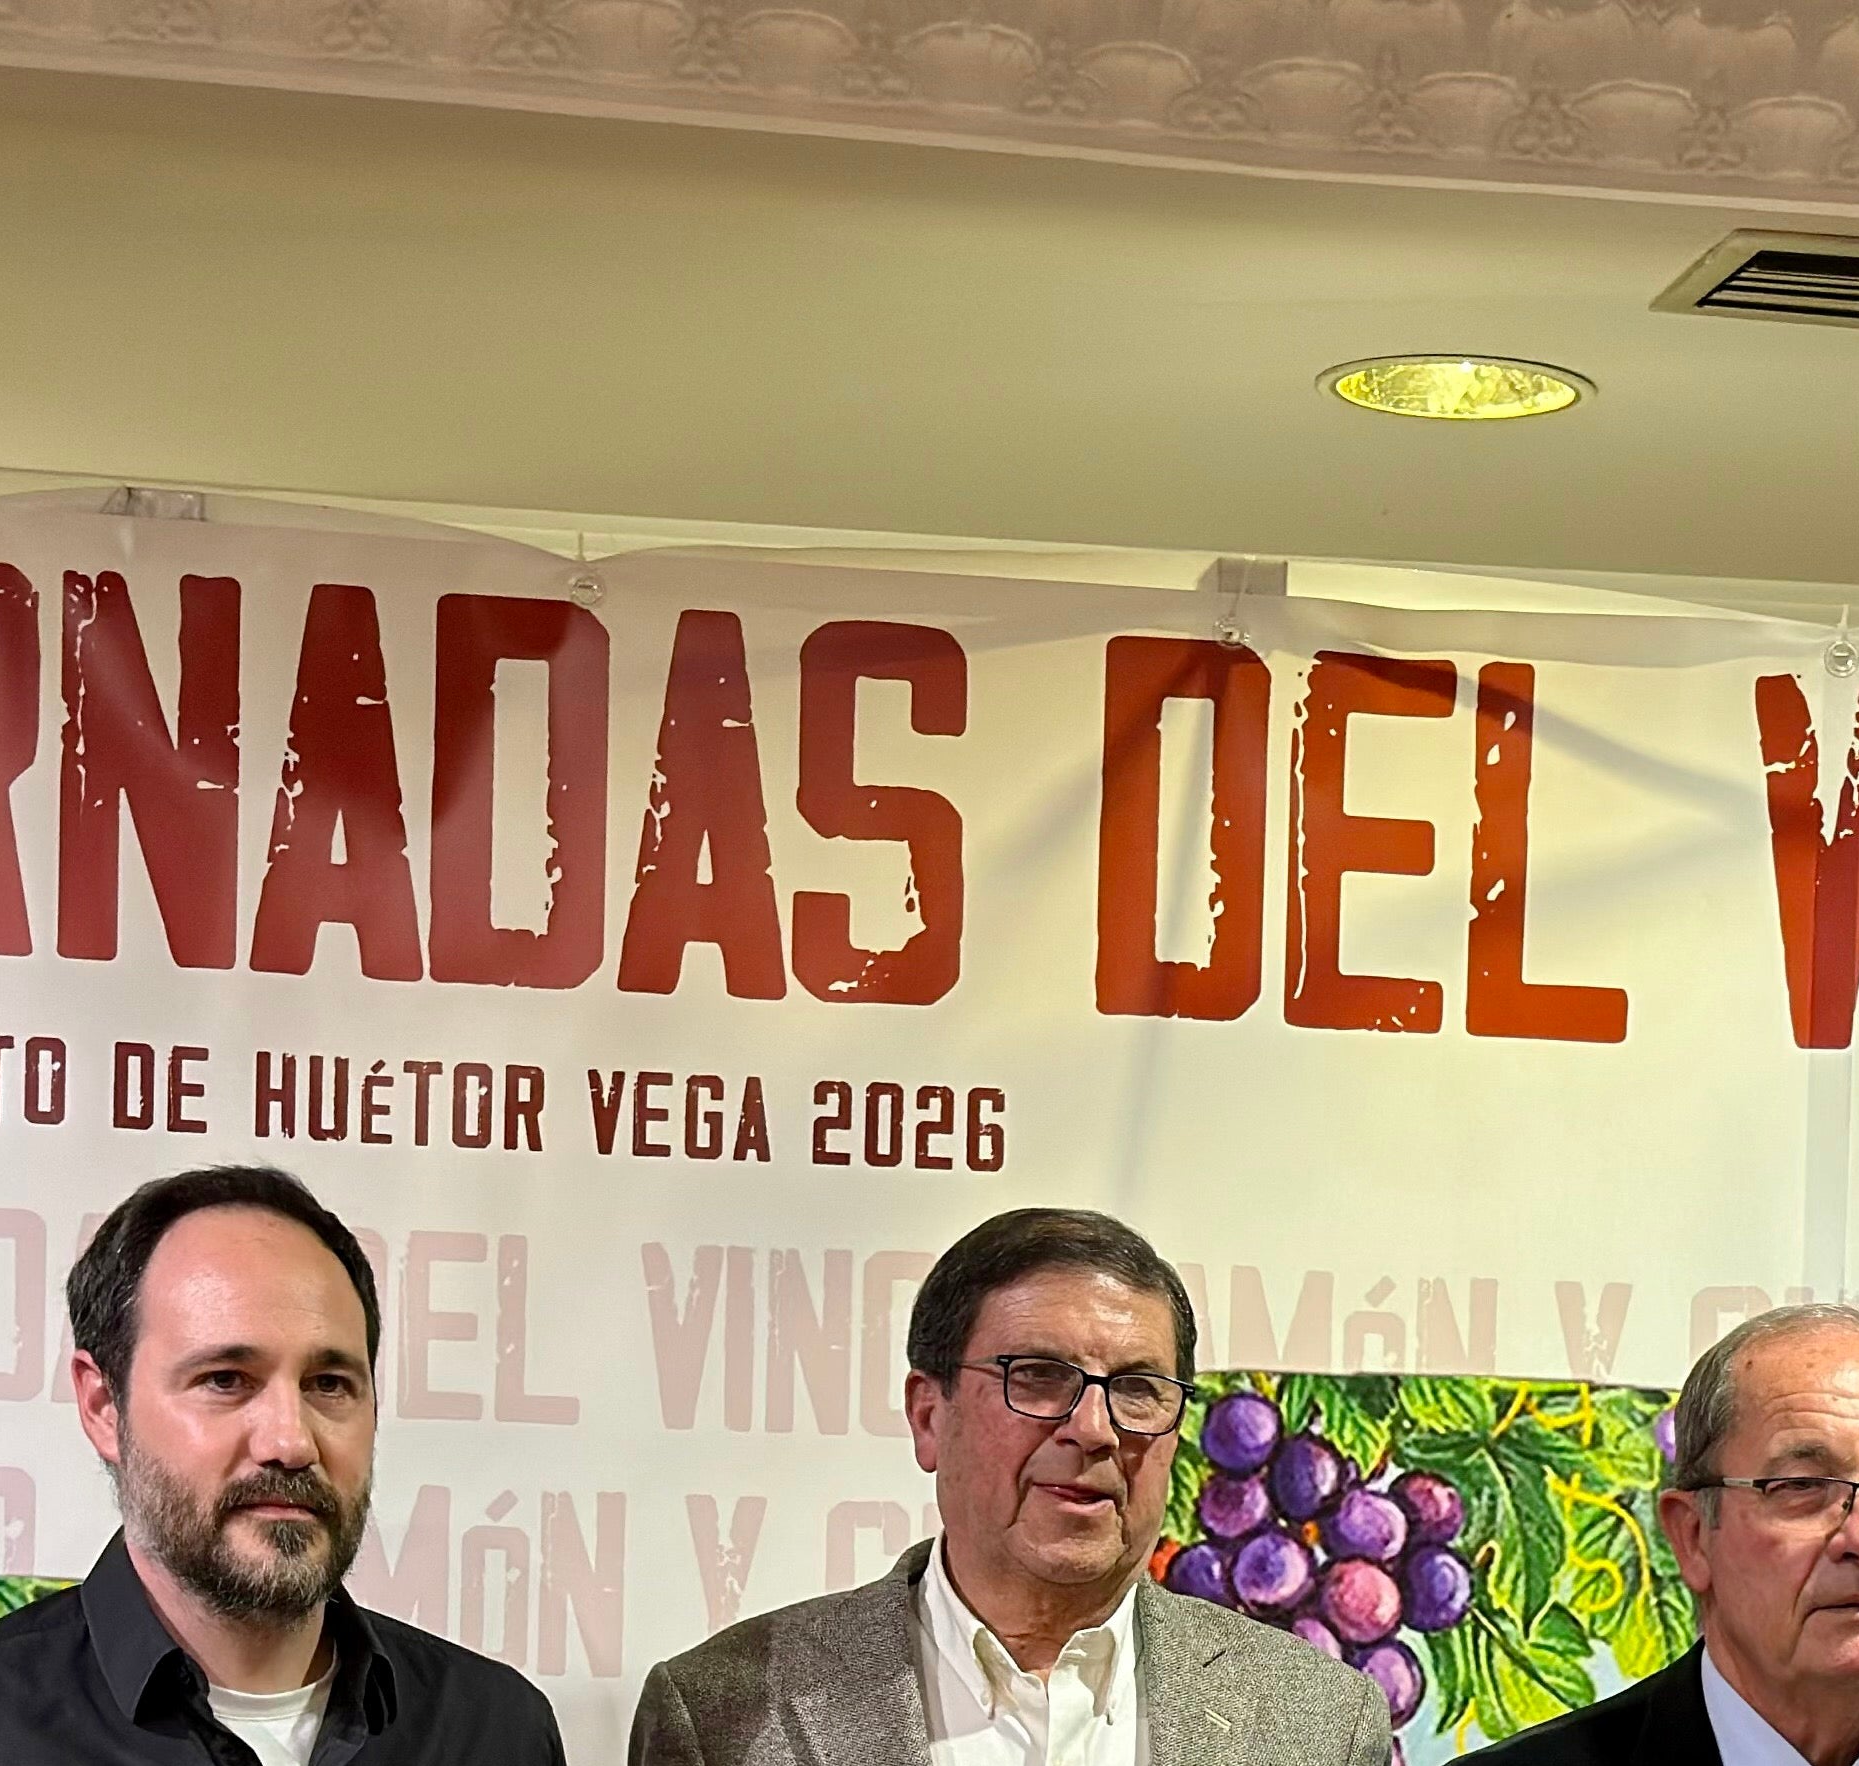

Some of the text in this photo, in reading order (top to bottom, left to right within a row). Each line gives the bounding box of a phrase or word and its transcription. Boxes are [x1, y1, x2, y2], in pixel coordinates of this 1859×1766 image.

[1095, 634, 1628, 1044] DEL
[113, 1043, 208, 1135] DE
[254, 1054, 548, 1153] HUÉTOR
[588, 1067, 770, 1164] VEGA
[810, 1080, 1007, 1172] 2026
